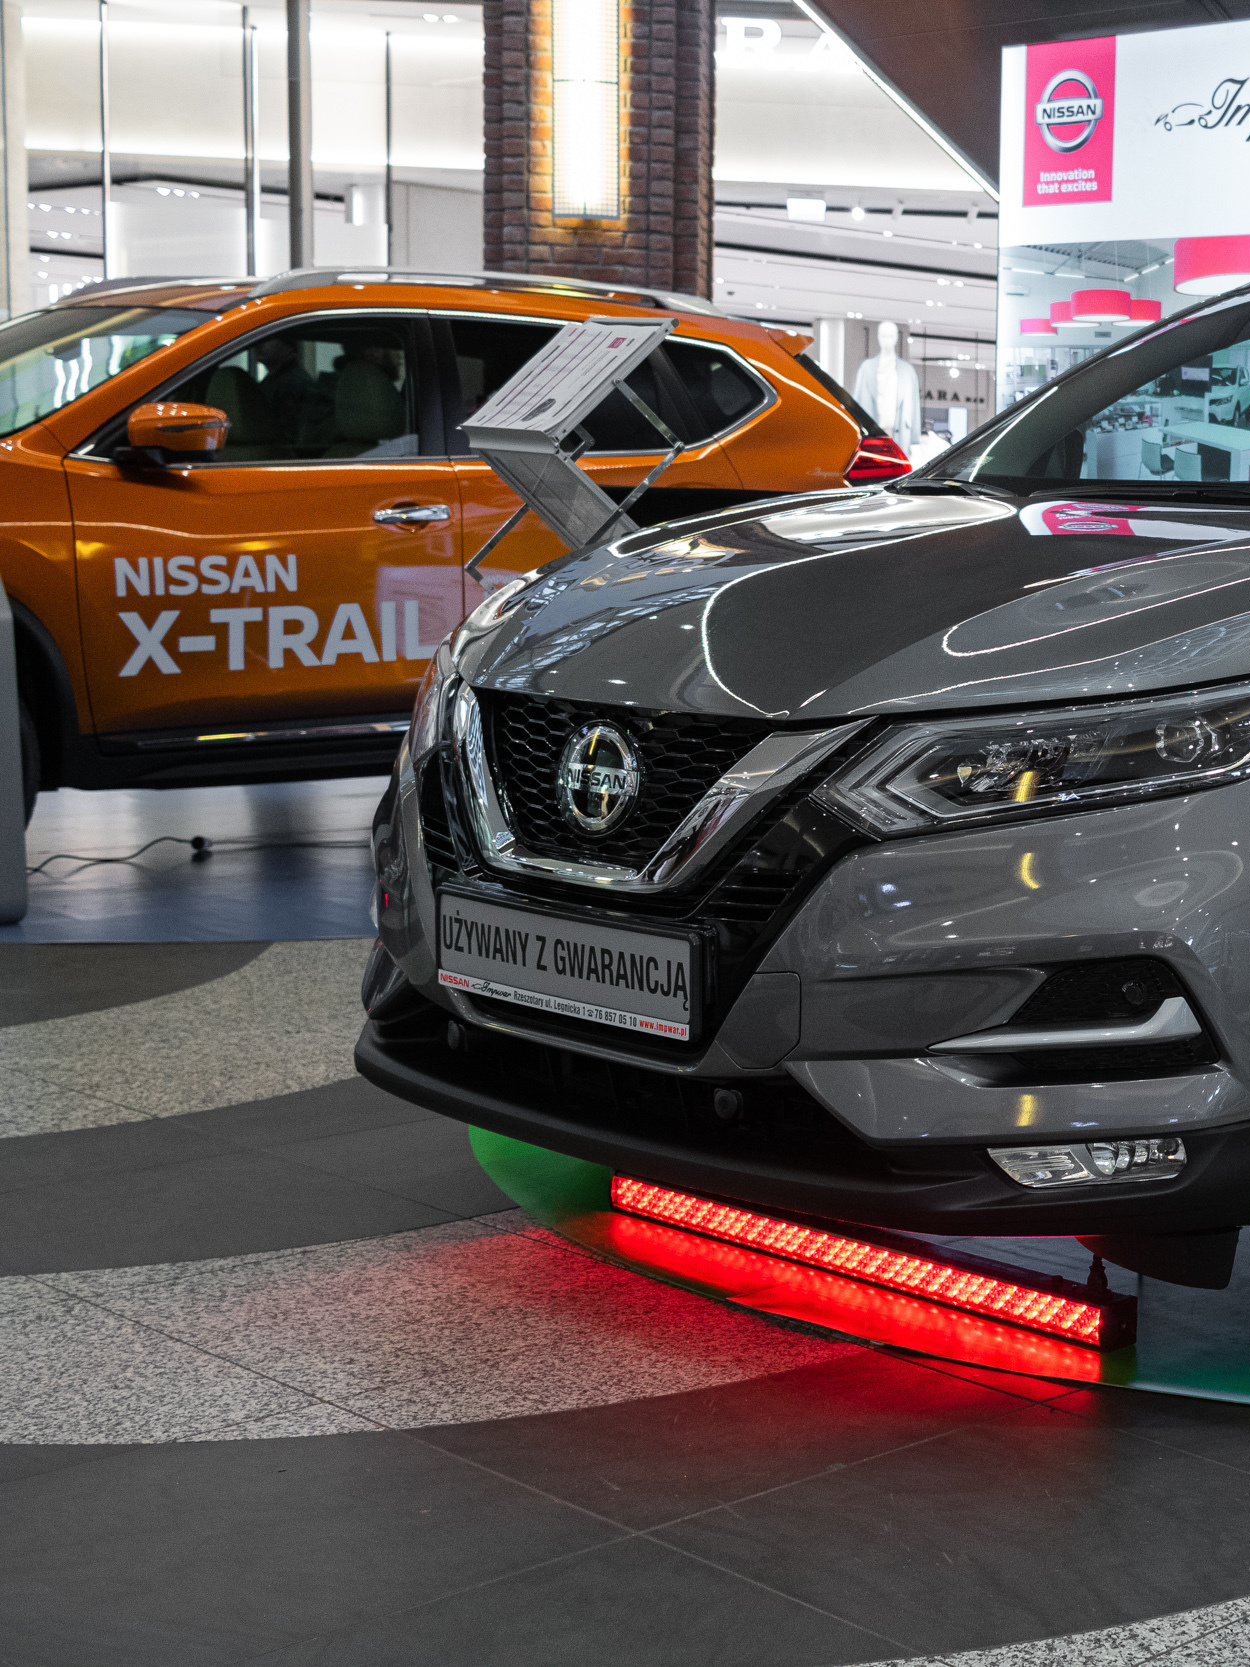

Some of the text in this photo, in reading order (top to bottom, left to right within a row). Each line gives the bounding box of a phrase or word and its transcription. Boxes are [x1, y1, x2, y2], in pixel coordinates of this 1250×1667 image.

[1041, 104, 1098, 121] NISSAN
[1036, 180, 1098, 195] that excites
[1039, 169, 1096, 183] Innovation
[114, 554, 298, 598] NISSAN
[118, 600, 438, 678] X-TRAIL
[566, 767, 627, 790] NISSAN
[442, 909, 689, 1012] UŻYWANY Z GWARANCJĄ
[440, 972, 470, 989] NISSAN
[480, 981, 512, 997] Impwar
[513, 990, 545, 1008] Rzeszotary
[545, 998, 553, 1010] ul.
[553, 1000, 581, 1016] Legnicka
[594, 1009, 603, 1020] 76
[604, 1011, 617, 1023] 857
[618, 1014, 628, 1025] 05
[628, 1016, 638, 1028] 10
[638, 1018, 688, 1037] www.impwar.pl
